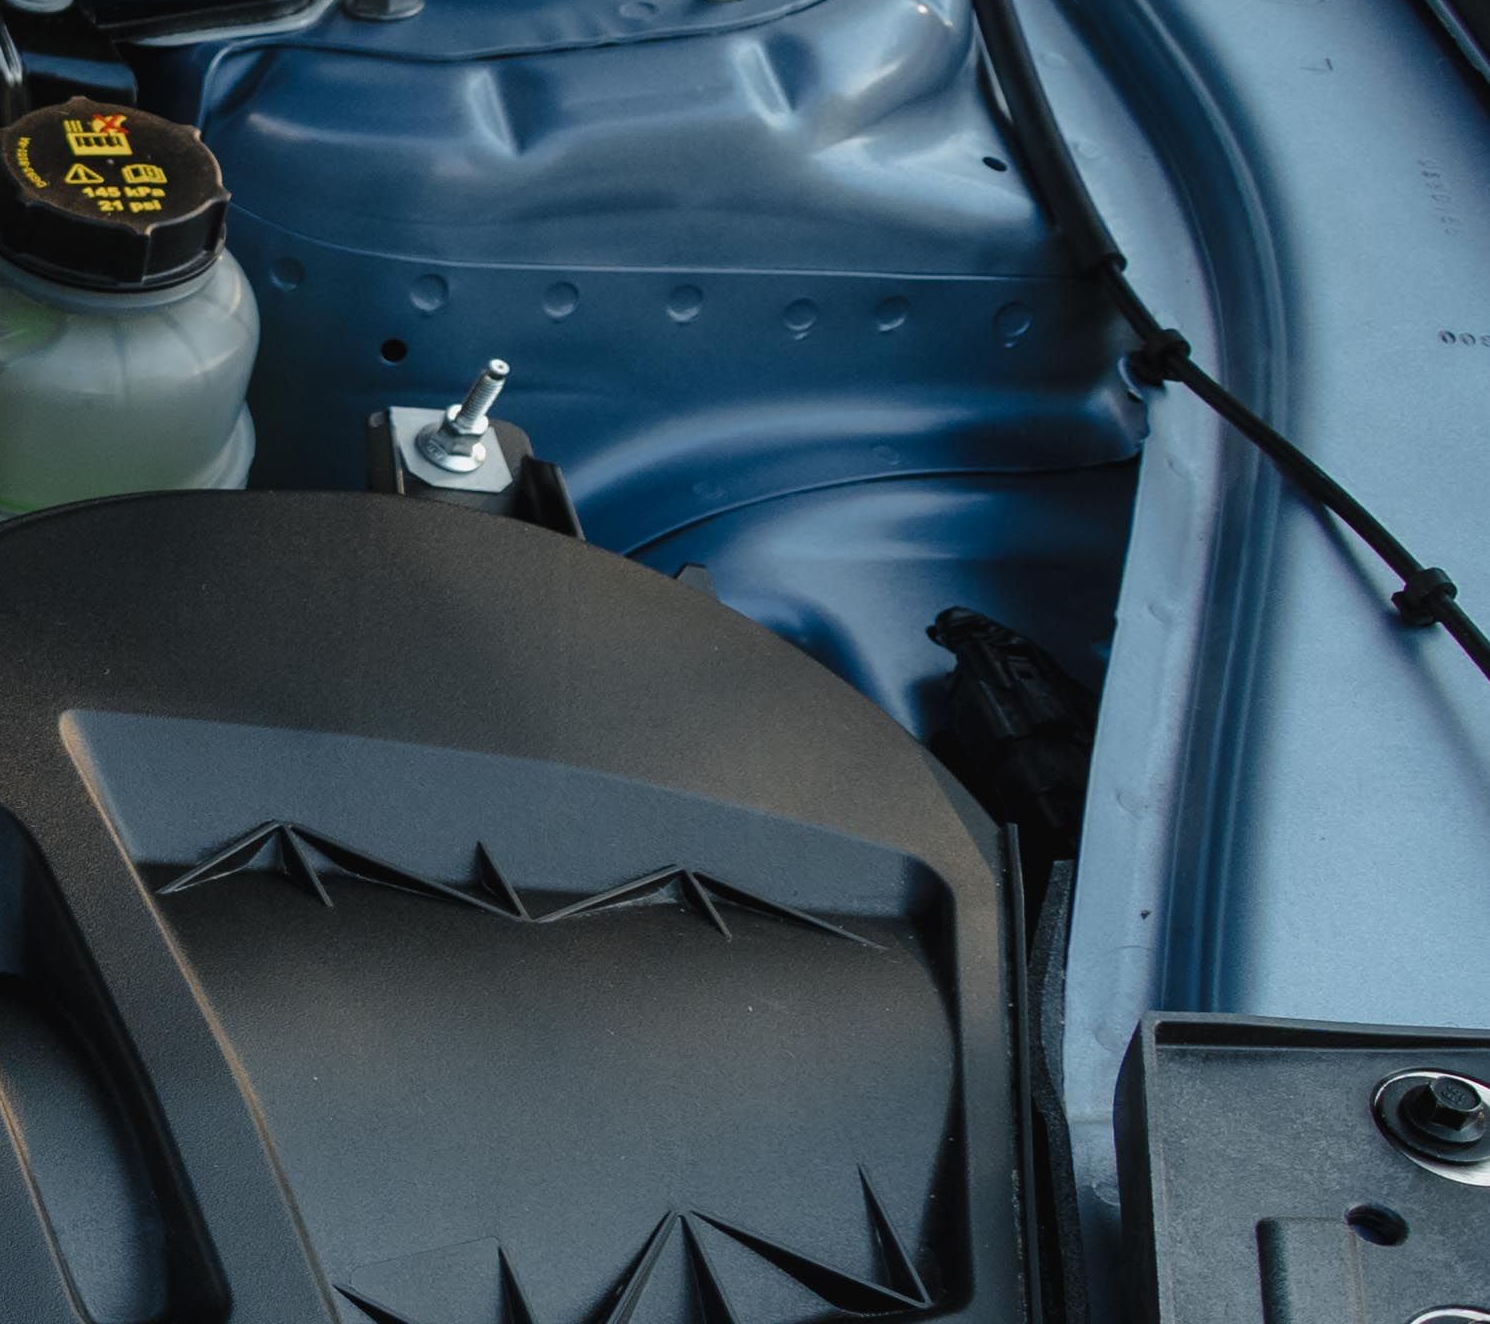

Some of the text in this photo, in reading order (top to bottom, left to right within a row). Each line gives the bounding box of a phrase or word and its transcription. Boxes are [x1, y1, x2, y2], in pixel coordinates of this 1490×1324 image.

[82, 185, 167, 199] 145 kPa
[97, 199, 163, 214] 21 psi
